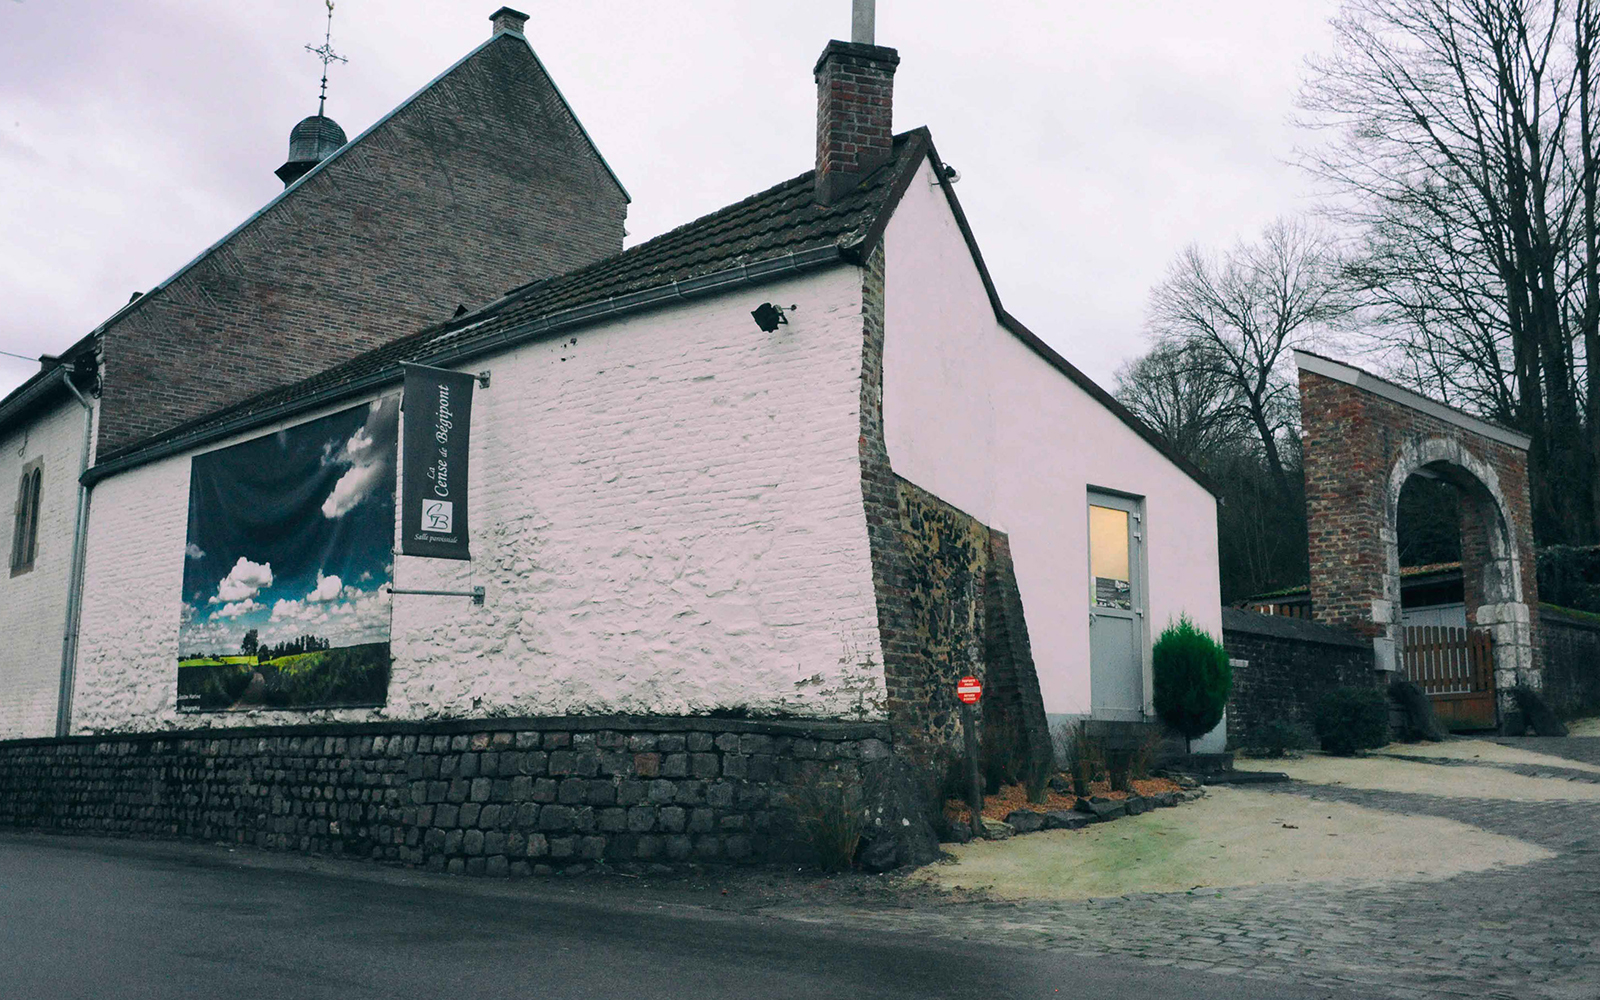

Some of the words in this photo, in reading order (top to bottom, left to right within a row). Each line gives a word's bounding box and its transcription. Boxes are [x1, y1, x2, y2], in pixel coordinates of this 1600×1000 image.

[435, 384, 453, 444] Bégipont
[438, 447, 448, 458] de
[427, 466, 435, 479] La
[433, 459, 449, 497] Cense
[414, 533, 429, 541] Salle
